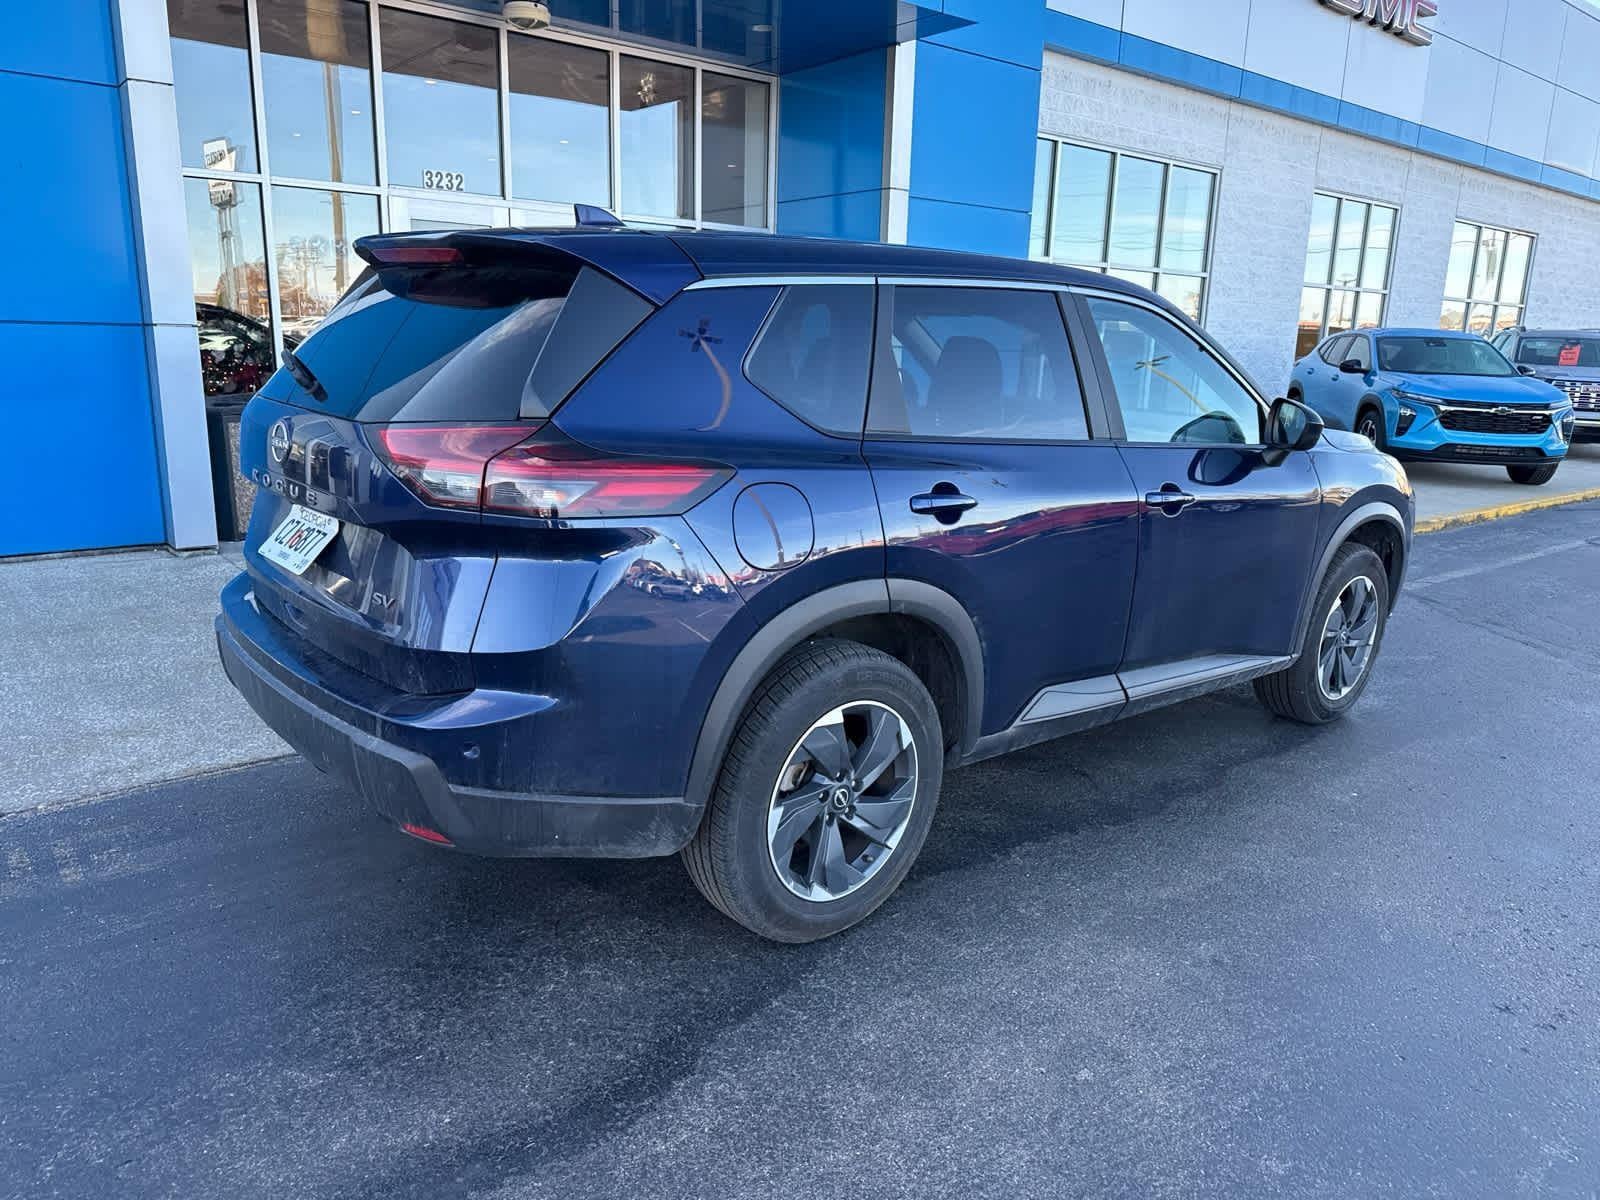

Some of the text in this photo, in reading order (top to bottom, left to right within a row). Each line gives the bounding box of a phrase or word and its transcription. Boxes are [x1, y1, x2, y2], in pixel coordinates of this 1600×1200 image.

[1312, 0, 1438, 46] MC
[425, 170, 464, 191] 3232
[252, 468, 318, 506] ROGUE
[372, 592, 394, 608] SV
